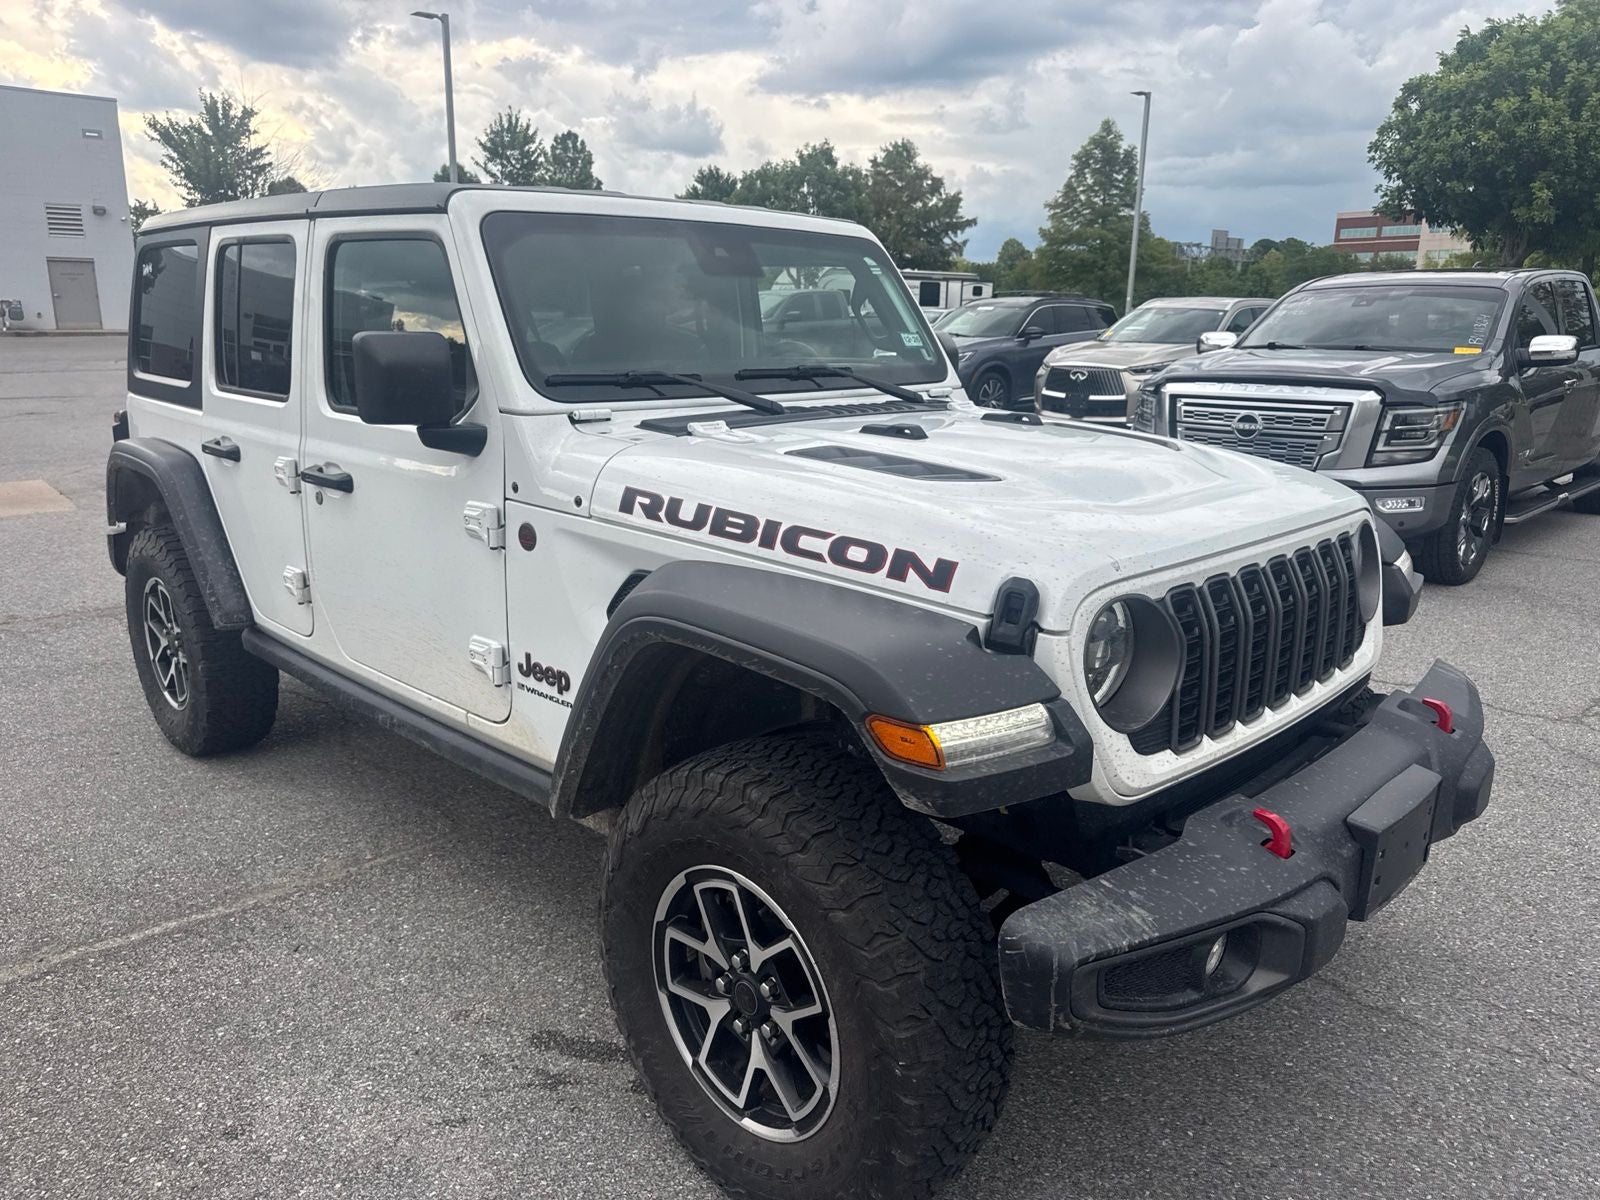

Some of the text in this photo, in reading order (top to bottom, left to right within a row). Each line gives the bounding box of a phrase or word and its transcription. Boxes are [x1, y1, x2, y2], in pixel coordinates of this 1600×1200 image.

[618, 486, 959, 593] RUBICON
[517, 651, 571, 696] Jeep
[525, 684, 573, 708] WRANGLER
